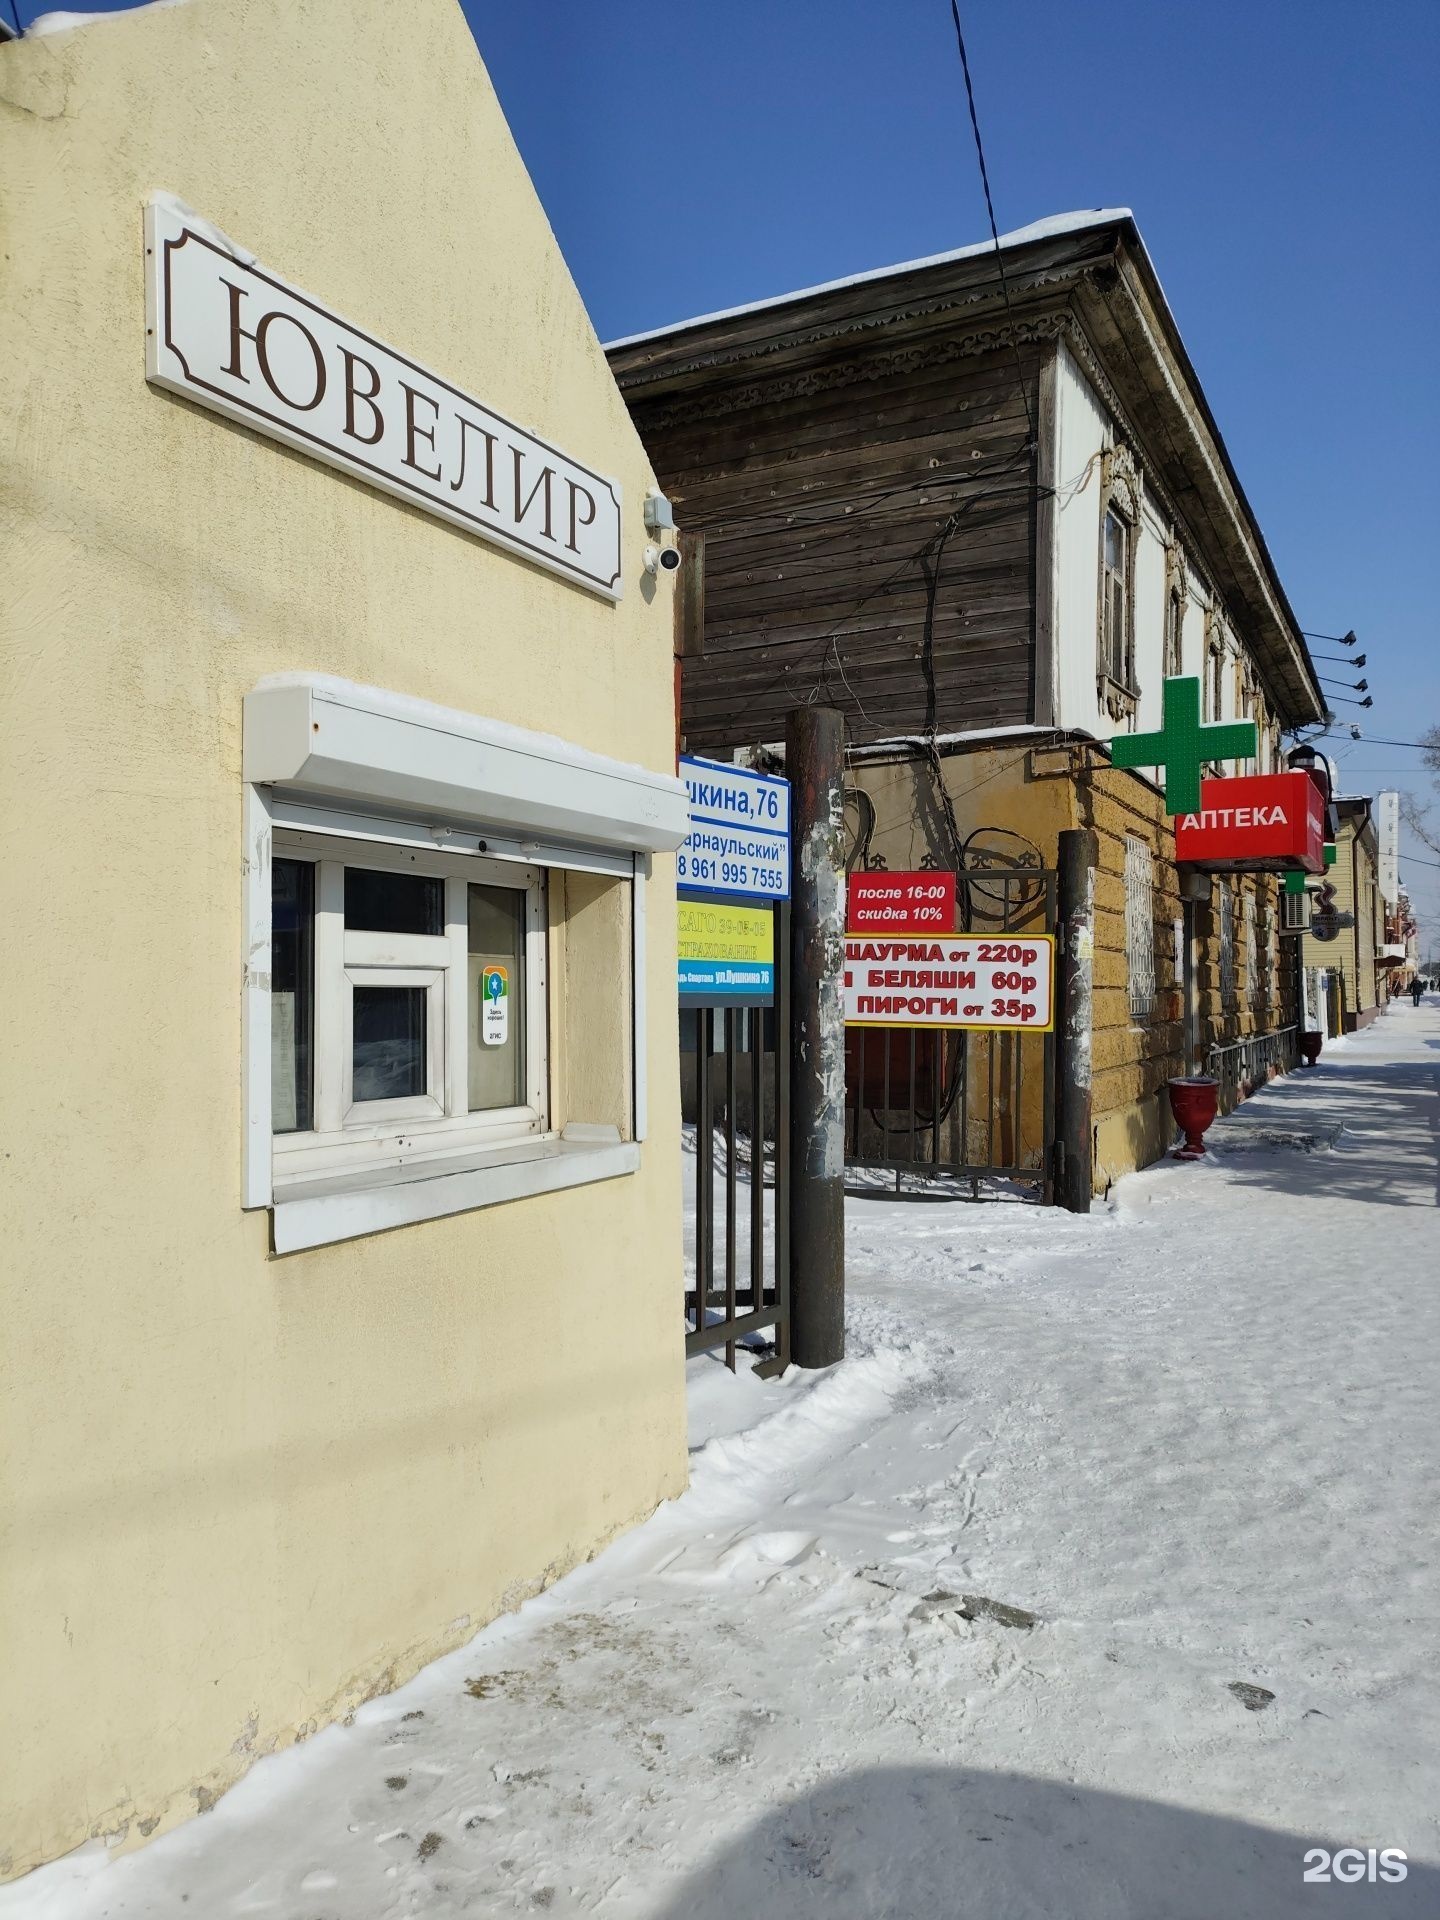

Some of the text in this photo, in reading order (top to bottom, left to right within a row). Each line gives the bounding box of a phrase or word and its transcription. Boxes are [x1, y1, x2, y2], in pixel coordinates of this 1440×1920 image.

[218, 276, 597, 555] ЮВЕЛИР
[1181, 805, 1288, 831] АПТЕКА
[678, 855, 783, 890] 8 961 995 7555
[857, 886, 946, 899] после 16-00
[857, 907, 943, 920] скидка 10%
[845, 943, 1038, 967] ШАУРМА от 220р
[760, 970, 770, 985] 76
[867, 969, 976, 989] БЕЛЯШИ
[991, 971, 1037, 994] 60р
[857, 995, 1037, 1021] ПИРОГИ от 35р
